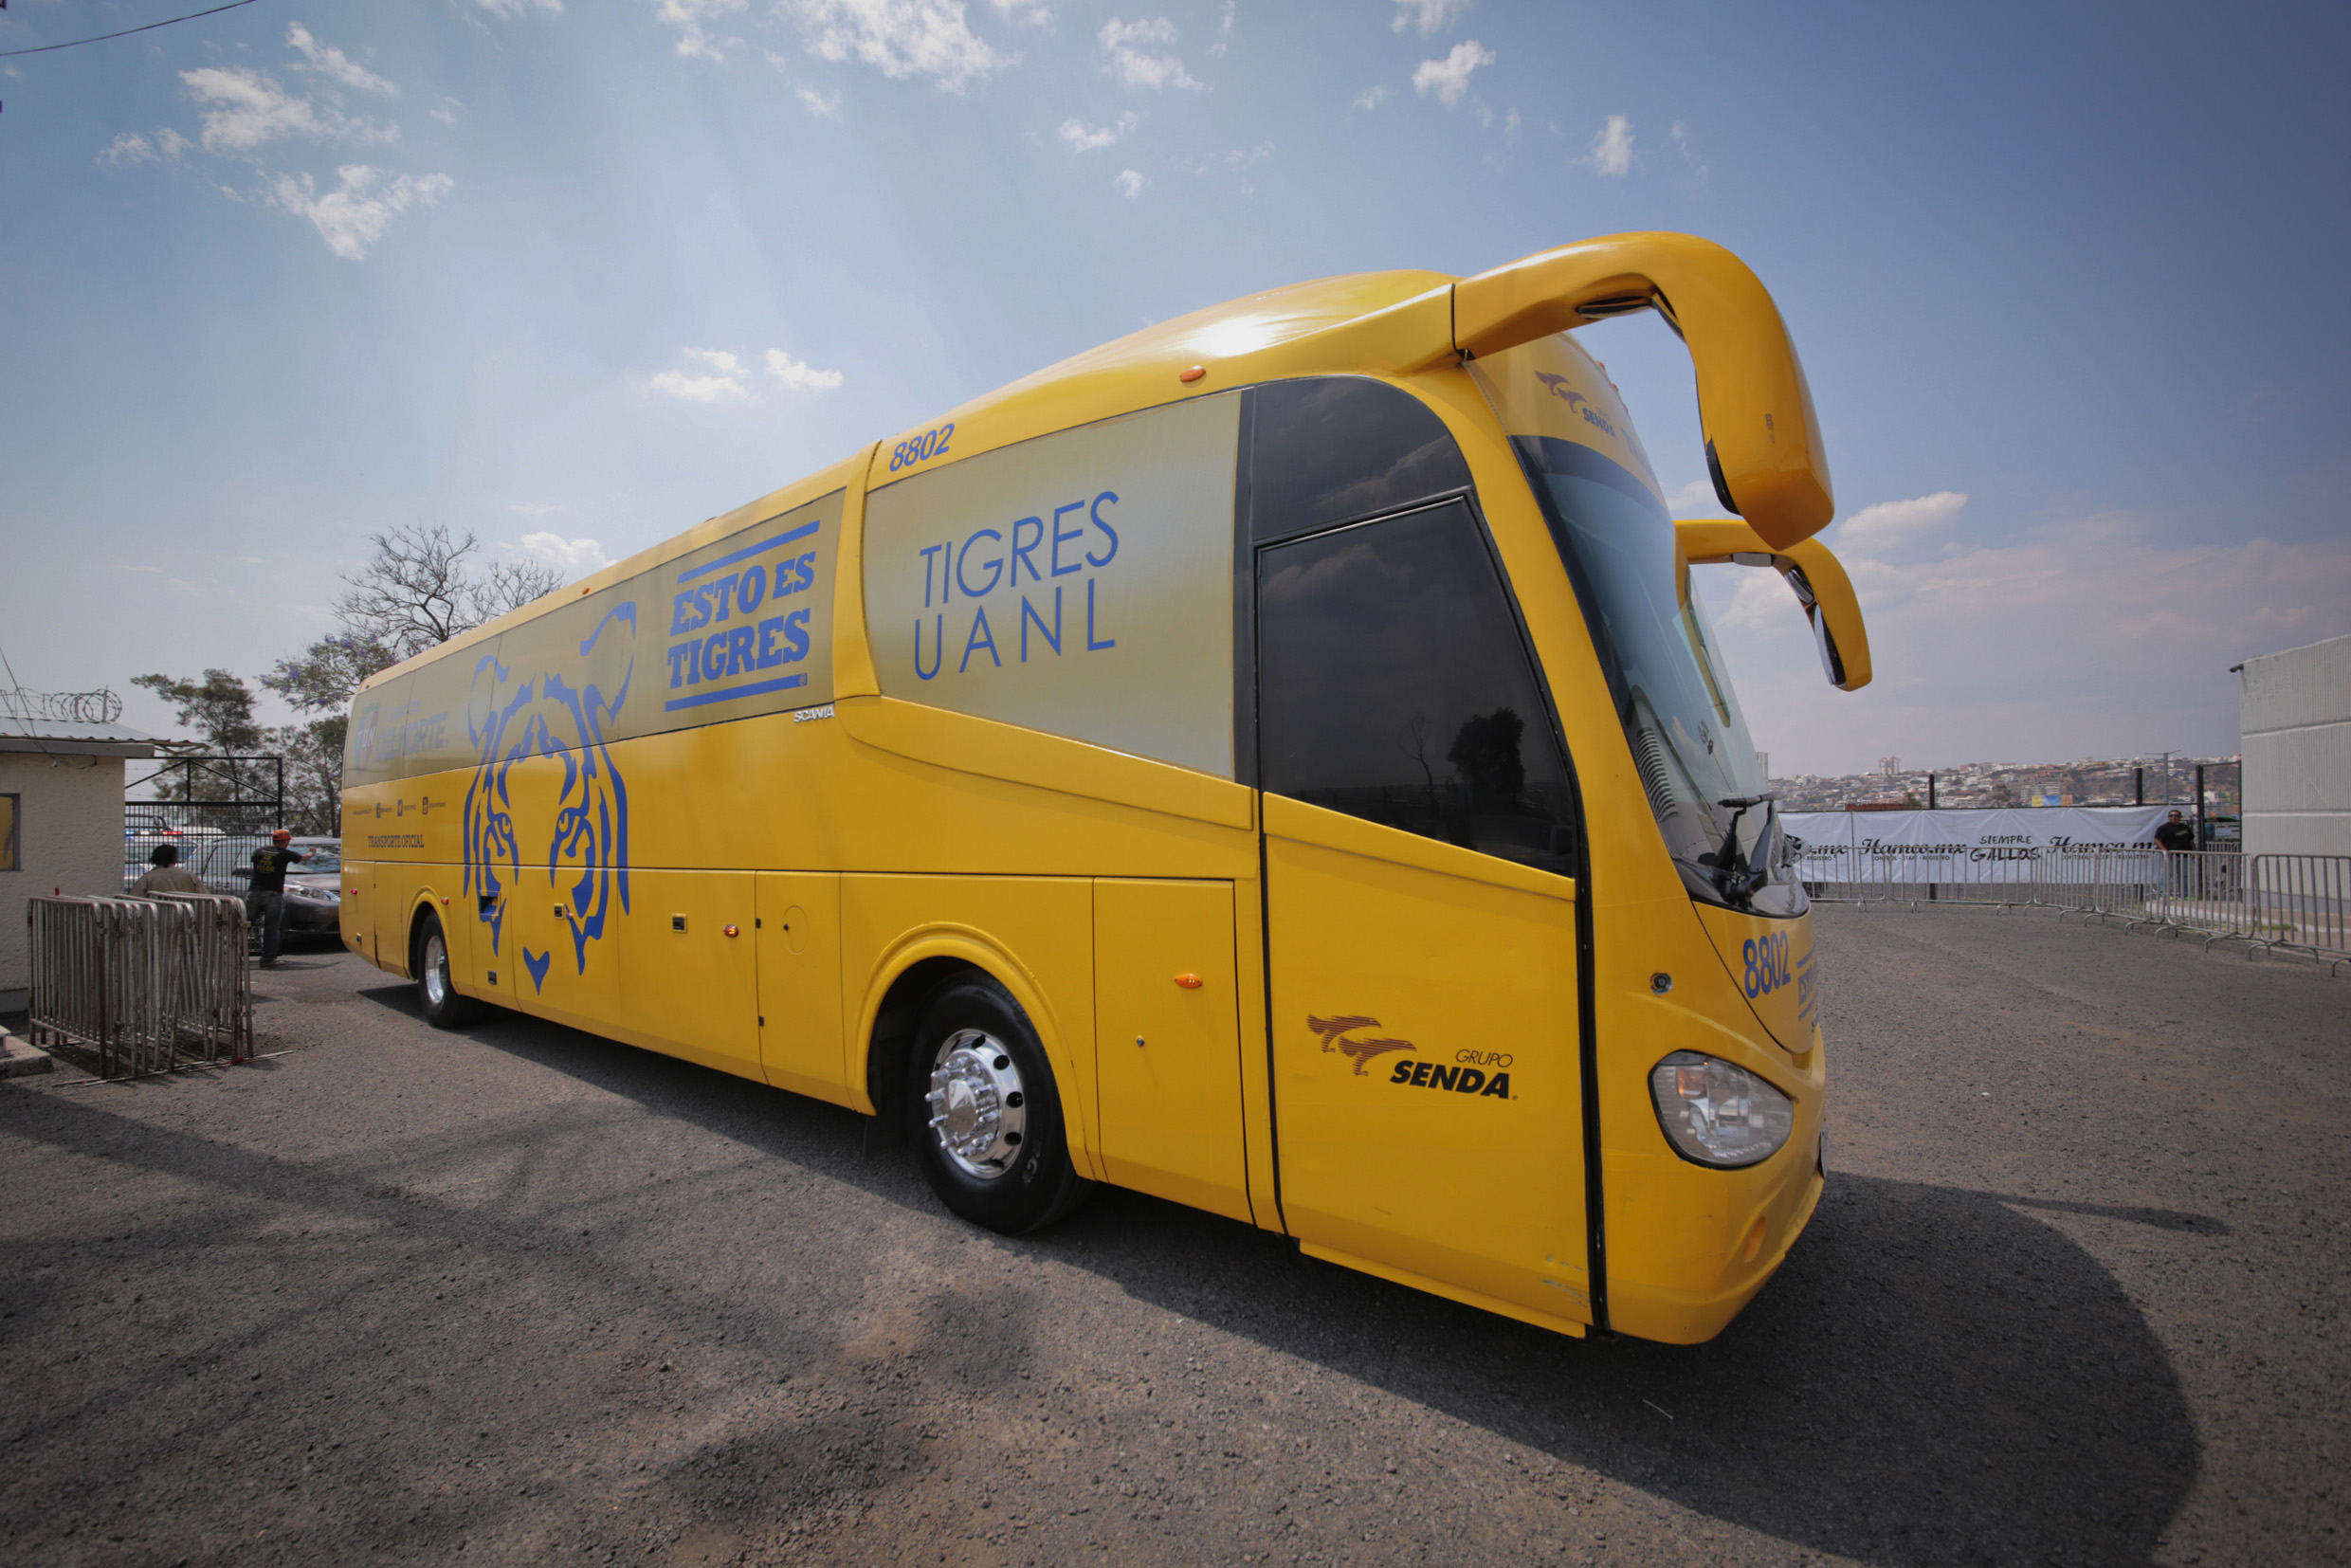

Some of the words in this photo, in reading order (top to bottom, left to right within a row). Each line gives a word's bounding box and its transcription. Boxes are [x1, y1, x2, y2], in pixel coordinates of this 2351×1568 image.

[1582, 407, 1617, 440] SENDA
[889, 423, 955, 472] 8802
[920, 491, 1120, 609] TIGRES
[669, 565, 767, 637] ESTO
[773, 551, 816, 600] ES
[666, 608, 811, 689] TIGRES
[915, 578, 1116, 681] UANL
[793, 706, 835, 723] SCANIA
[368, 834, 401, 848] TRANSPORTE
[402, 834, 425, 848] OFICIAL
[1970, 846, 2041, 862] GALLOS
[1979, 835, 2032, 845] SIEMPRE
[1742, 929, 1791, 999] 8802
[1455, 1048, 1514, 1068] GRUPO
[1390, 1060, 1509, 1100] SENDA
